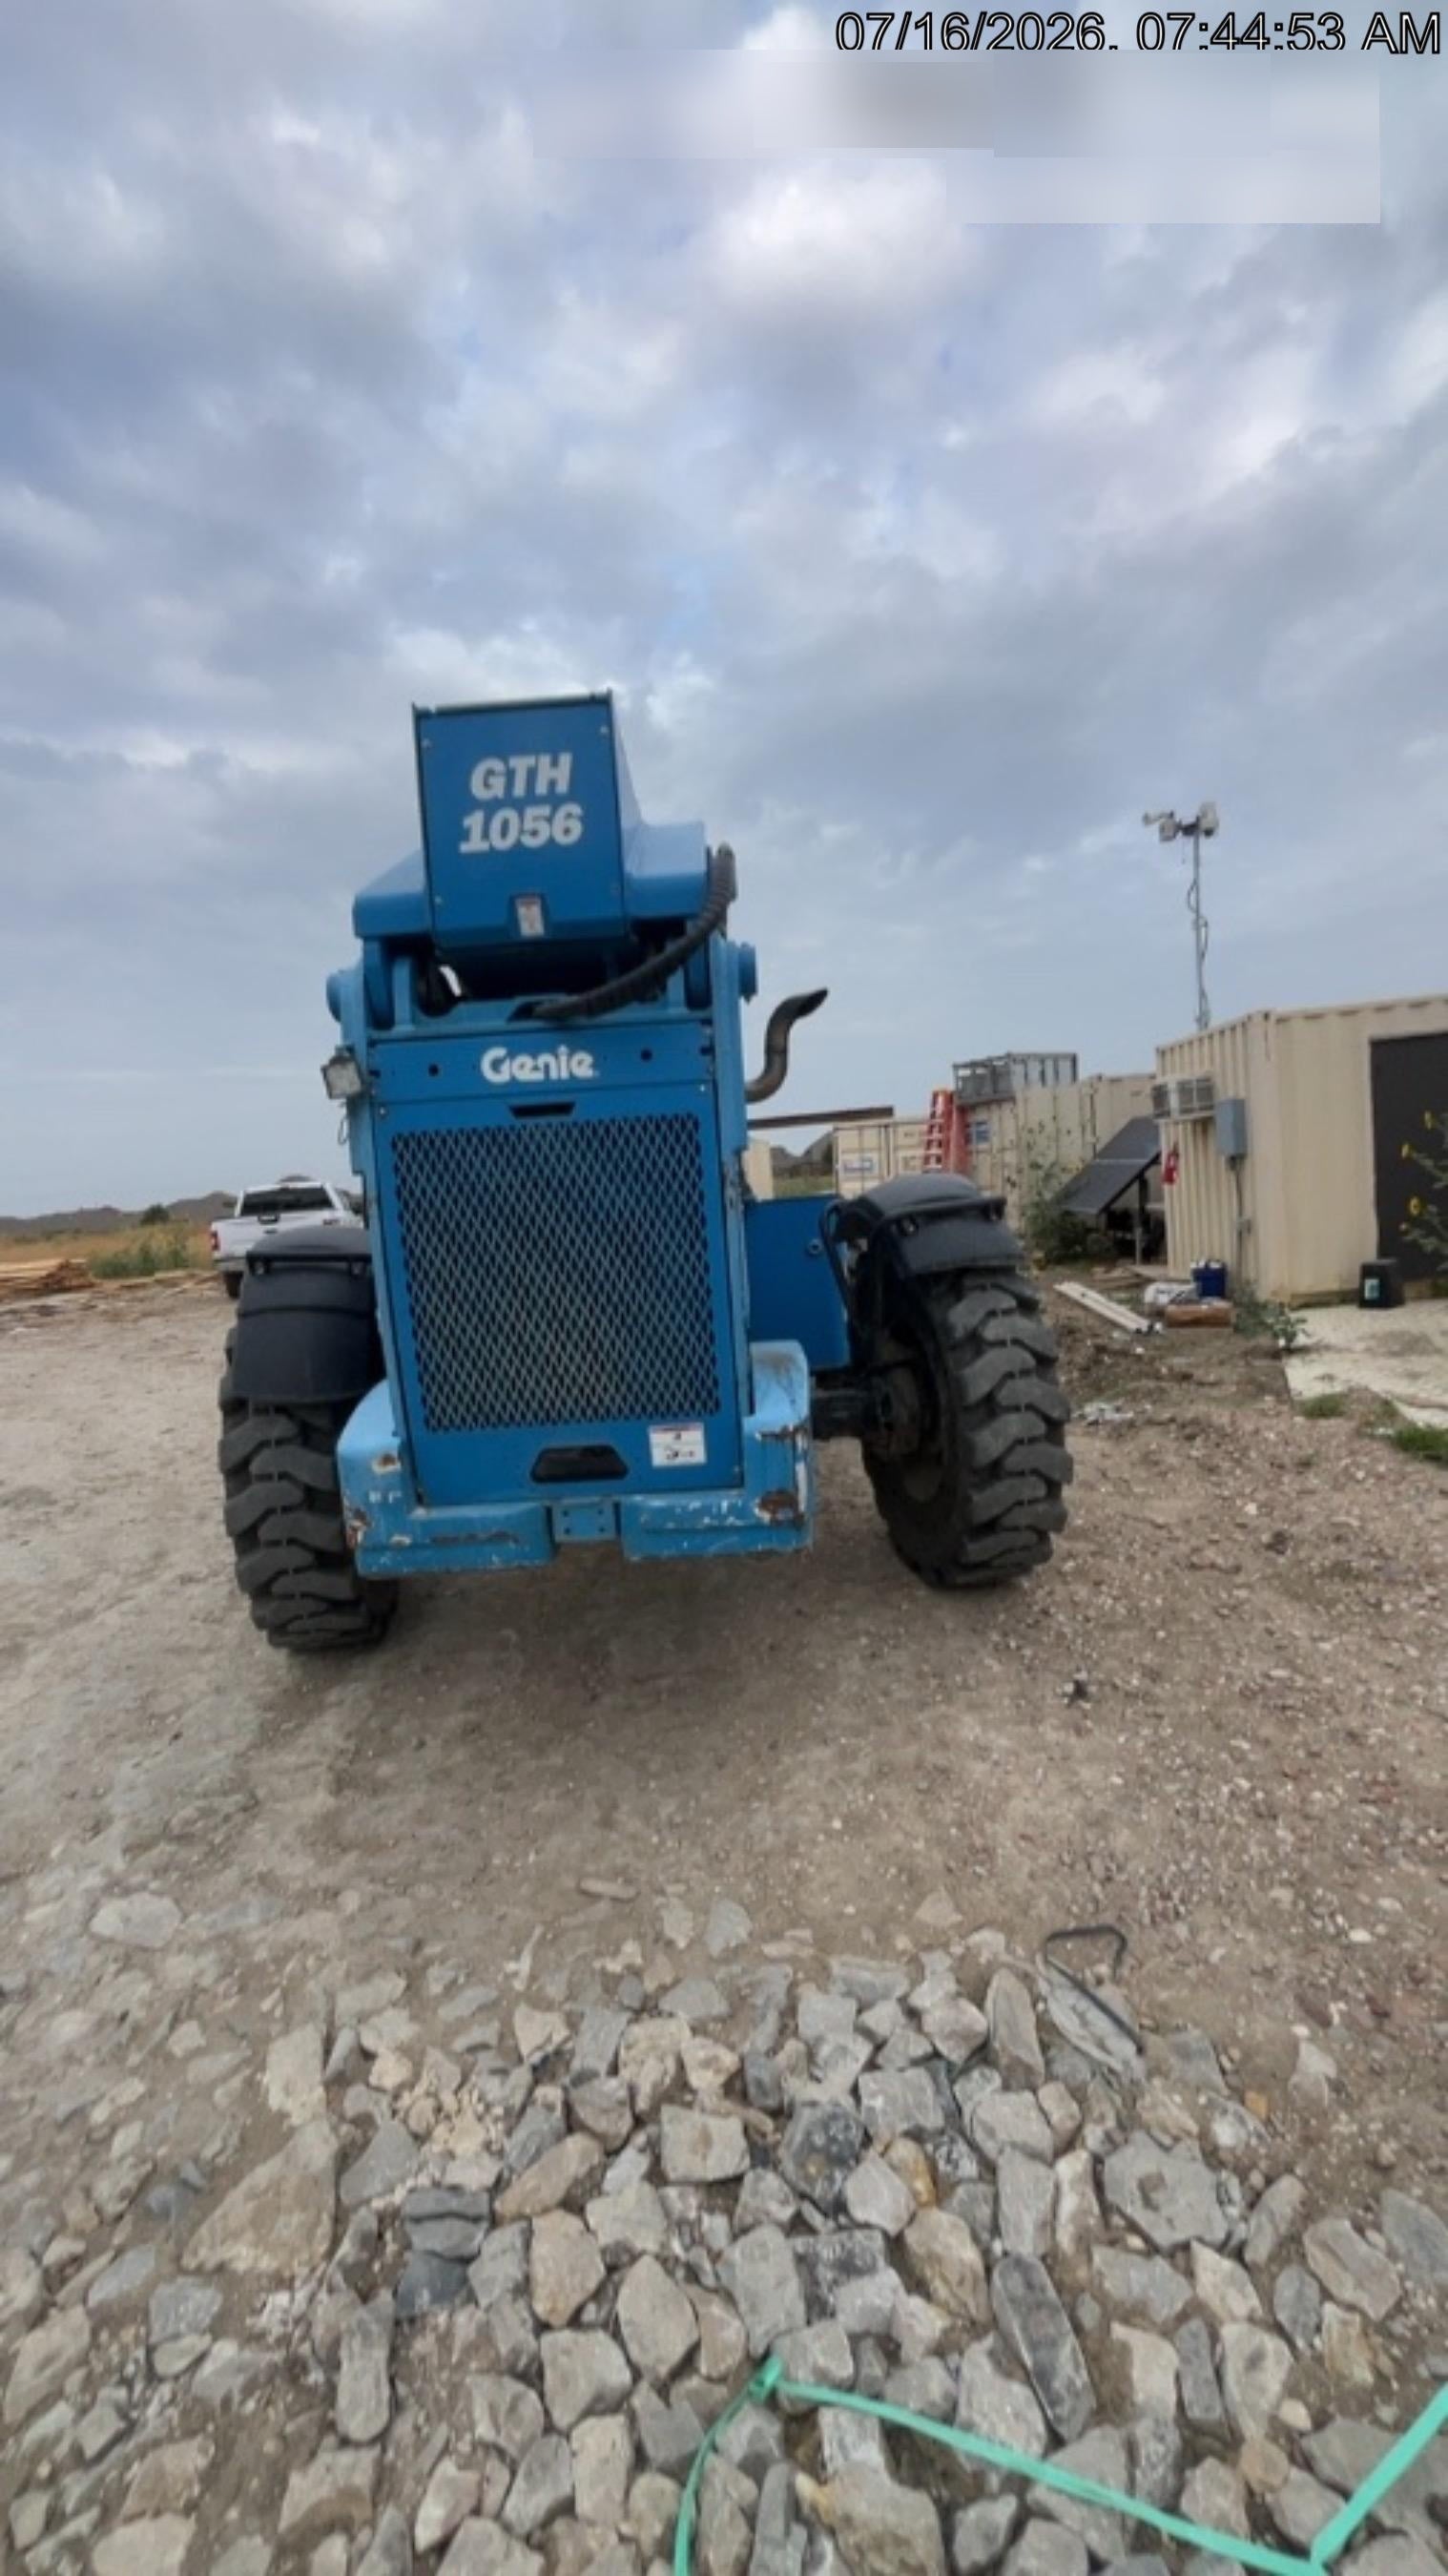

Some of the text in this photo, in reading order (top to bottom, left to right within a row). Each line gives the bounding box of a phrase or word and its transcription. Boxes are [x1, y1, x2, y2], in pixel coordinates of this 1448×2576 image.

[470, 752, 572, 800] GTH
[459, 803, 583, 853] 1056
[480, 1045, 594, 1083] Genie
